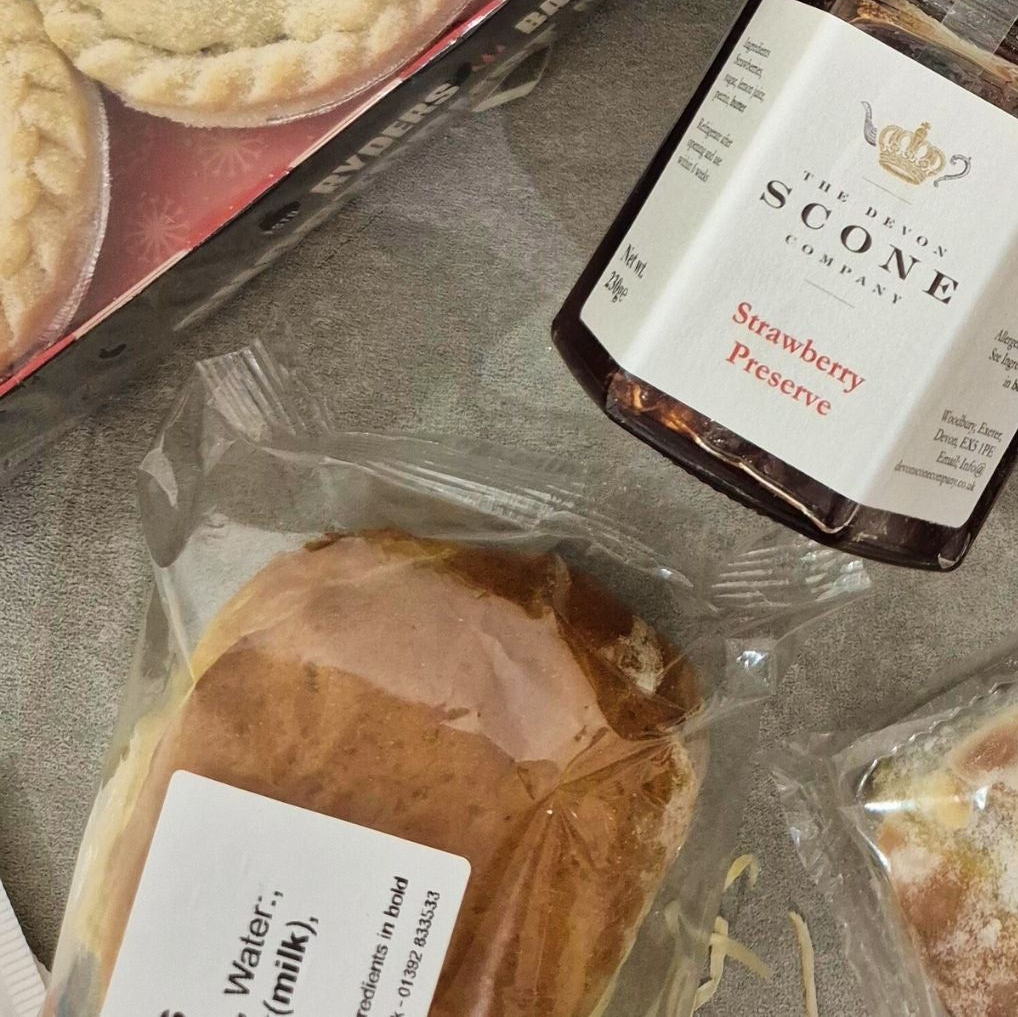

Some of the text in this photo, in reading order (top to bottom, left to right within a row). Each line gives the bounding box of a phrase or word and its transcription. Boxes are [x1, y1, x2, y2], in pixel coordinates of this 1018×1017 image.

[758, 179, 960, 306] SCONE
[802, 170, 948, 259] THE DEVON
[620, 243, 639, 269] Net
[784, 233, 903, 306] COMPANY
[724, 342, 832, 417] Preserve
[731, 301, 866, 395] Strawberry
[958, 435, 978, 452] EX5
[977, 442, 997, 458] 1PE
[376, 921, 396, 941] in
[383, 875, 410, 919] bold
[397, 949, 424, 998] 01392
[413, 890, 442, 948] 833533
